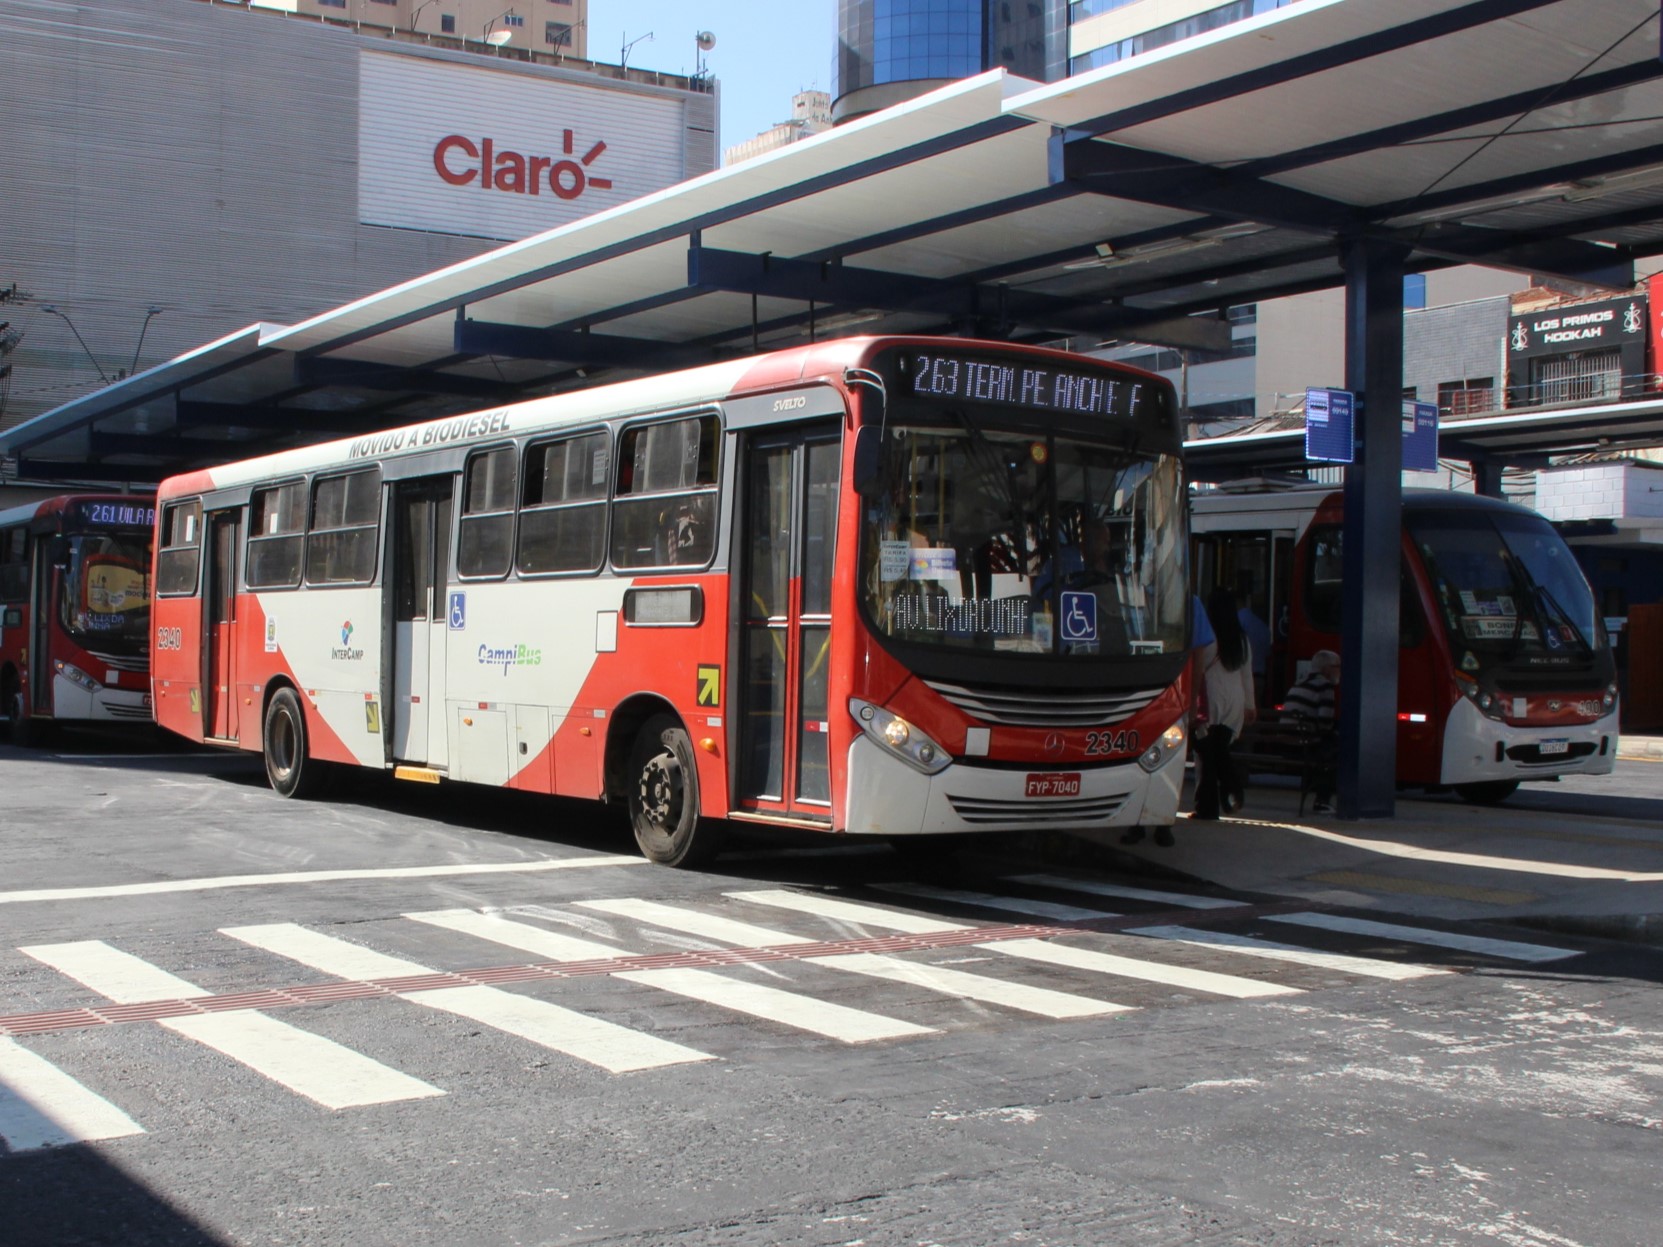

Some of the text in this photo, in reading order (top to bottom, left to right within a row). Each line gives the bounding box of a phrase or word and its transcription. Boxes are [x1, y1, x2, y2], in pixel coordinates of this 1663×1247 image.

[433, 134, 586, 200] Claro
[1533, 310, 1614, 332] LOS PRIMOS
[1544, 326, 1602, 343] HOOKAH
[773, 396, 806, 412] SVELTO
[349, 410, 511, 458] MOVIDO A BIODIESEL
[145, 508, 155, 525] R
[157, 627, 182, 651] 2340
[478, 643, 542, 677] CampiBus
[1085, 730, 1139, 755] 2340
